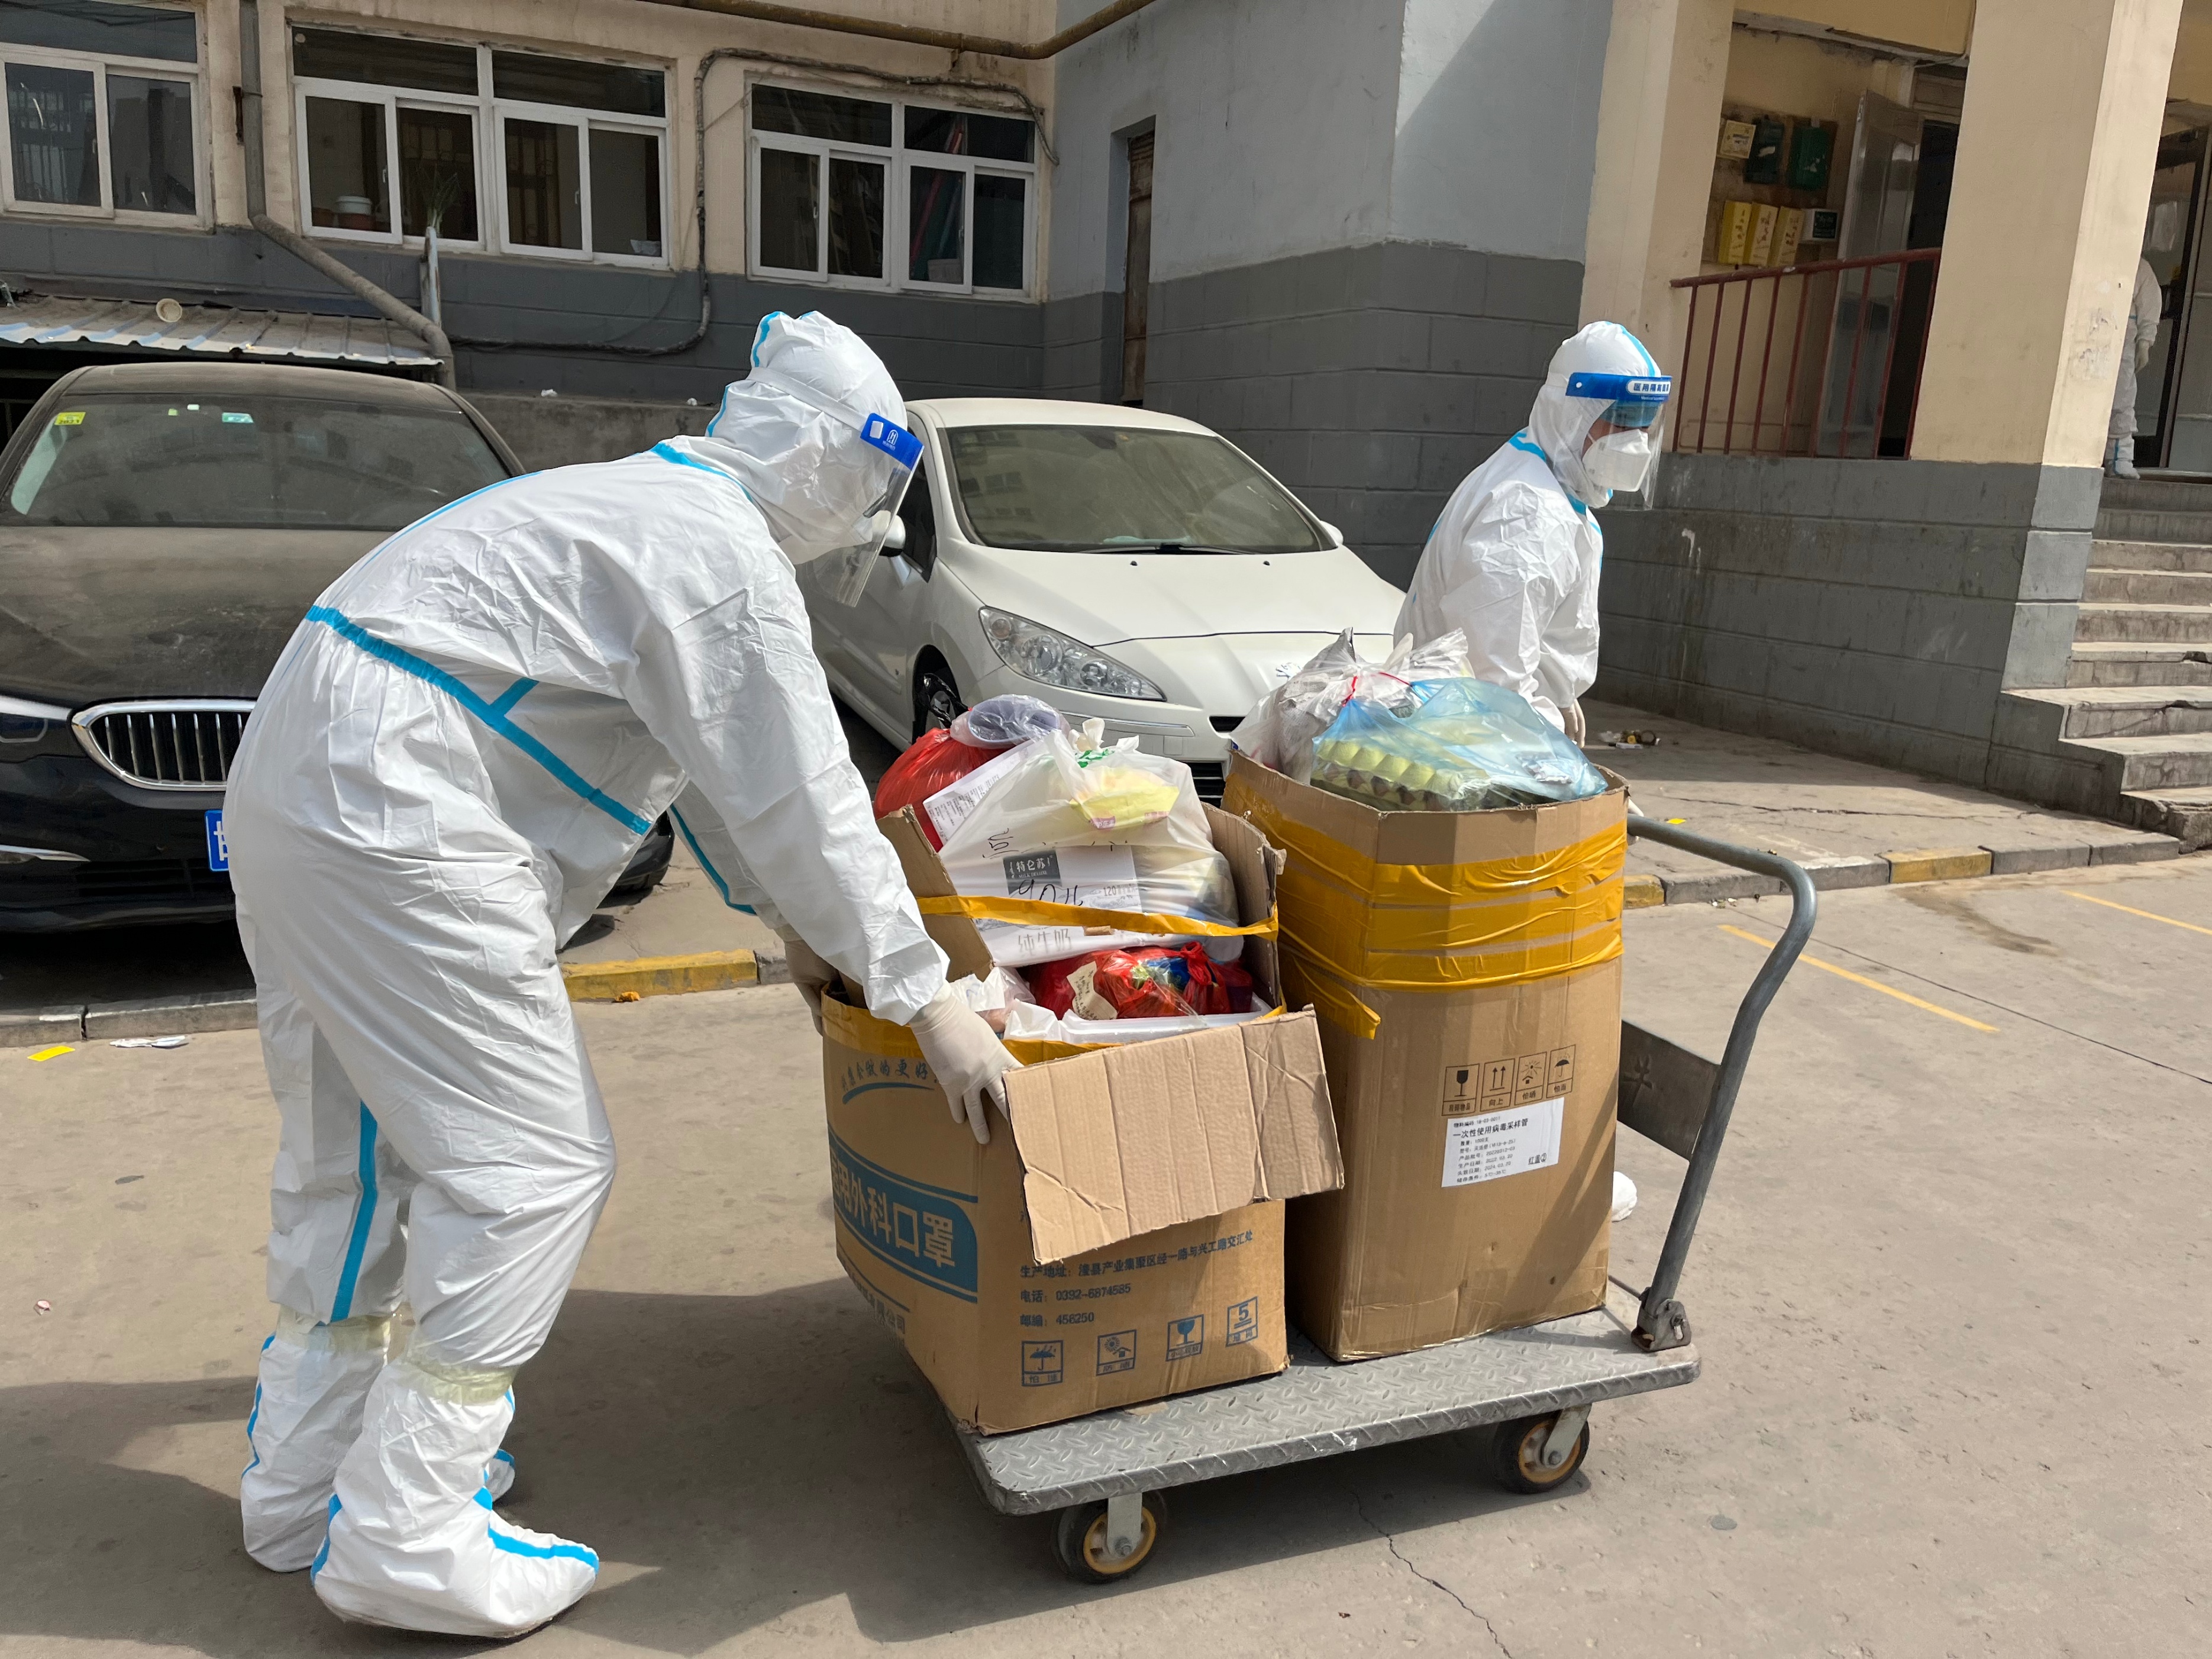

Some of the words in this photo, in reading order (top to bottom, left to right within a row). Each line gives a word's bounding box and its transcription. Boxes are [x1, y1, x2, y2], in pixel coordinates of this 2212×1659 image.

[1016, 857, 1046, 873] 特仑苏
[1018, 928, 1071, 956] 纯牛奶
[1522, 1090, 1536, 1100] 怕晒
[1554, 1083, 1567, 1093] 怕雨
[1488, 1098, 1504, 1107] 向上
[1453, 1118, 1529, 1138] 一次性使用病毒采样管
[1238, 1302, 1249, 1321] 5
